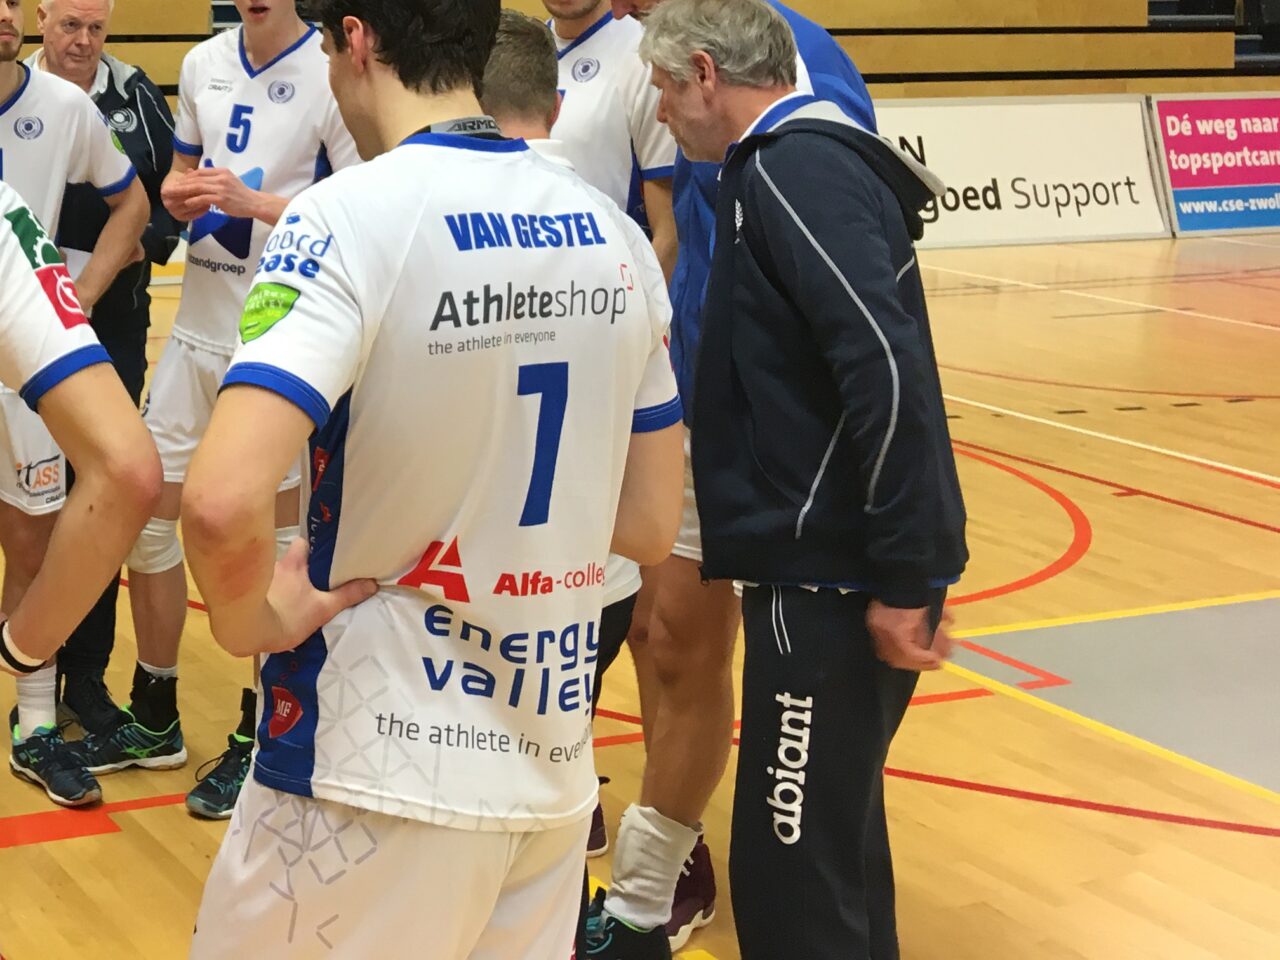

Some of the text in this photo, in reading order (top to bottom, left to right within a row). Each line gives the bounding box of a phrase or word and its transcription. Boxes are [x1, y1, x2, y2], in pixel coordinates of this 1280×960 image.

[226, 104, 254, 154] 5
[1166, 113, 1279, 141] Dé weg naar
[899, 135, 926, 167] N
[918, 175, 1140, 223] goed Support
[266, 230, 333, 257] oord
[444, 212, 607, 251] VAN GESTEL
[256, 253, 320, 278] ease
[429, 280, 626, 331] Athleteshop
[428, 330, 556, 355] the athlete in everyone
[517, 362, 568, 527] 7
[493, 562, 605, 596] Alfa-colle
[277, 700, 292, 718] MF
[375, 713, 420, 741] the
[429, 724, 510, 753] athlete
[518, 733, 540, 757] in
[767, 692, 813, 845] abiant
